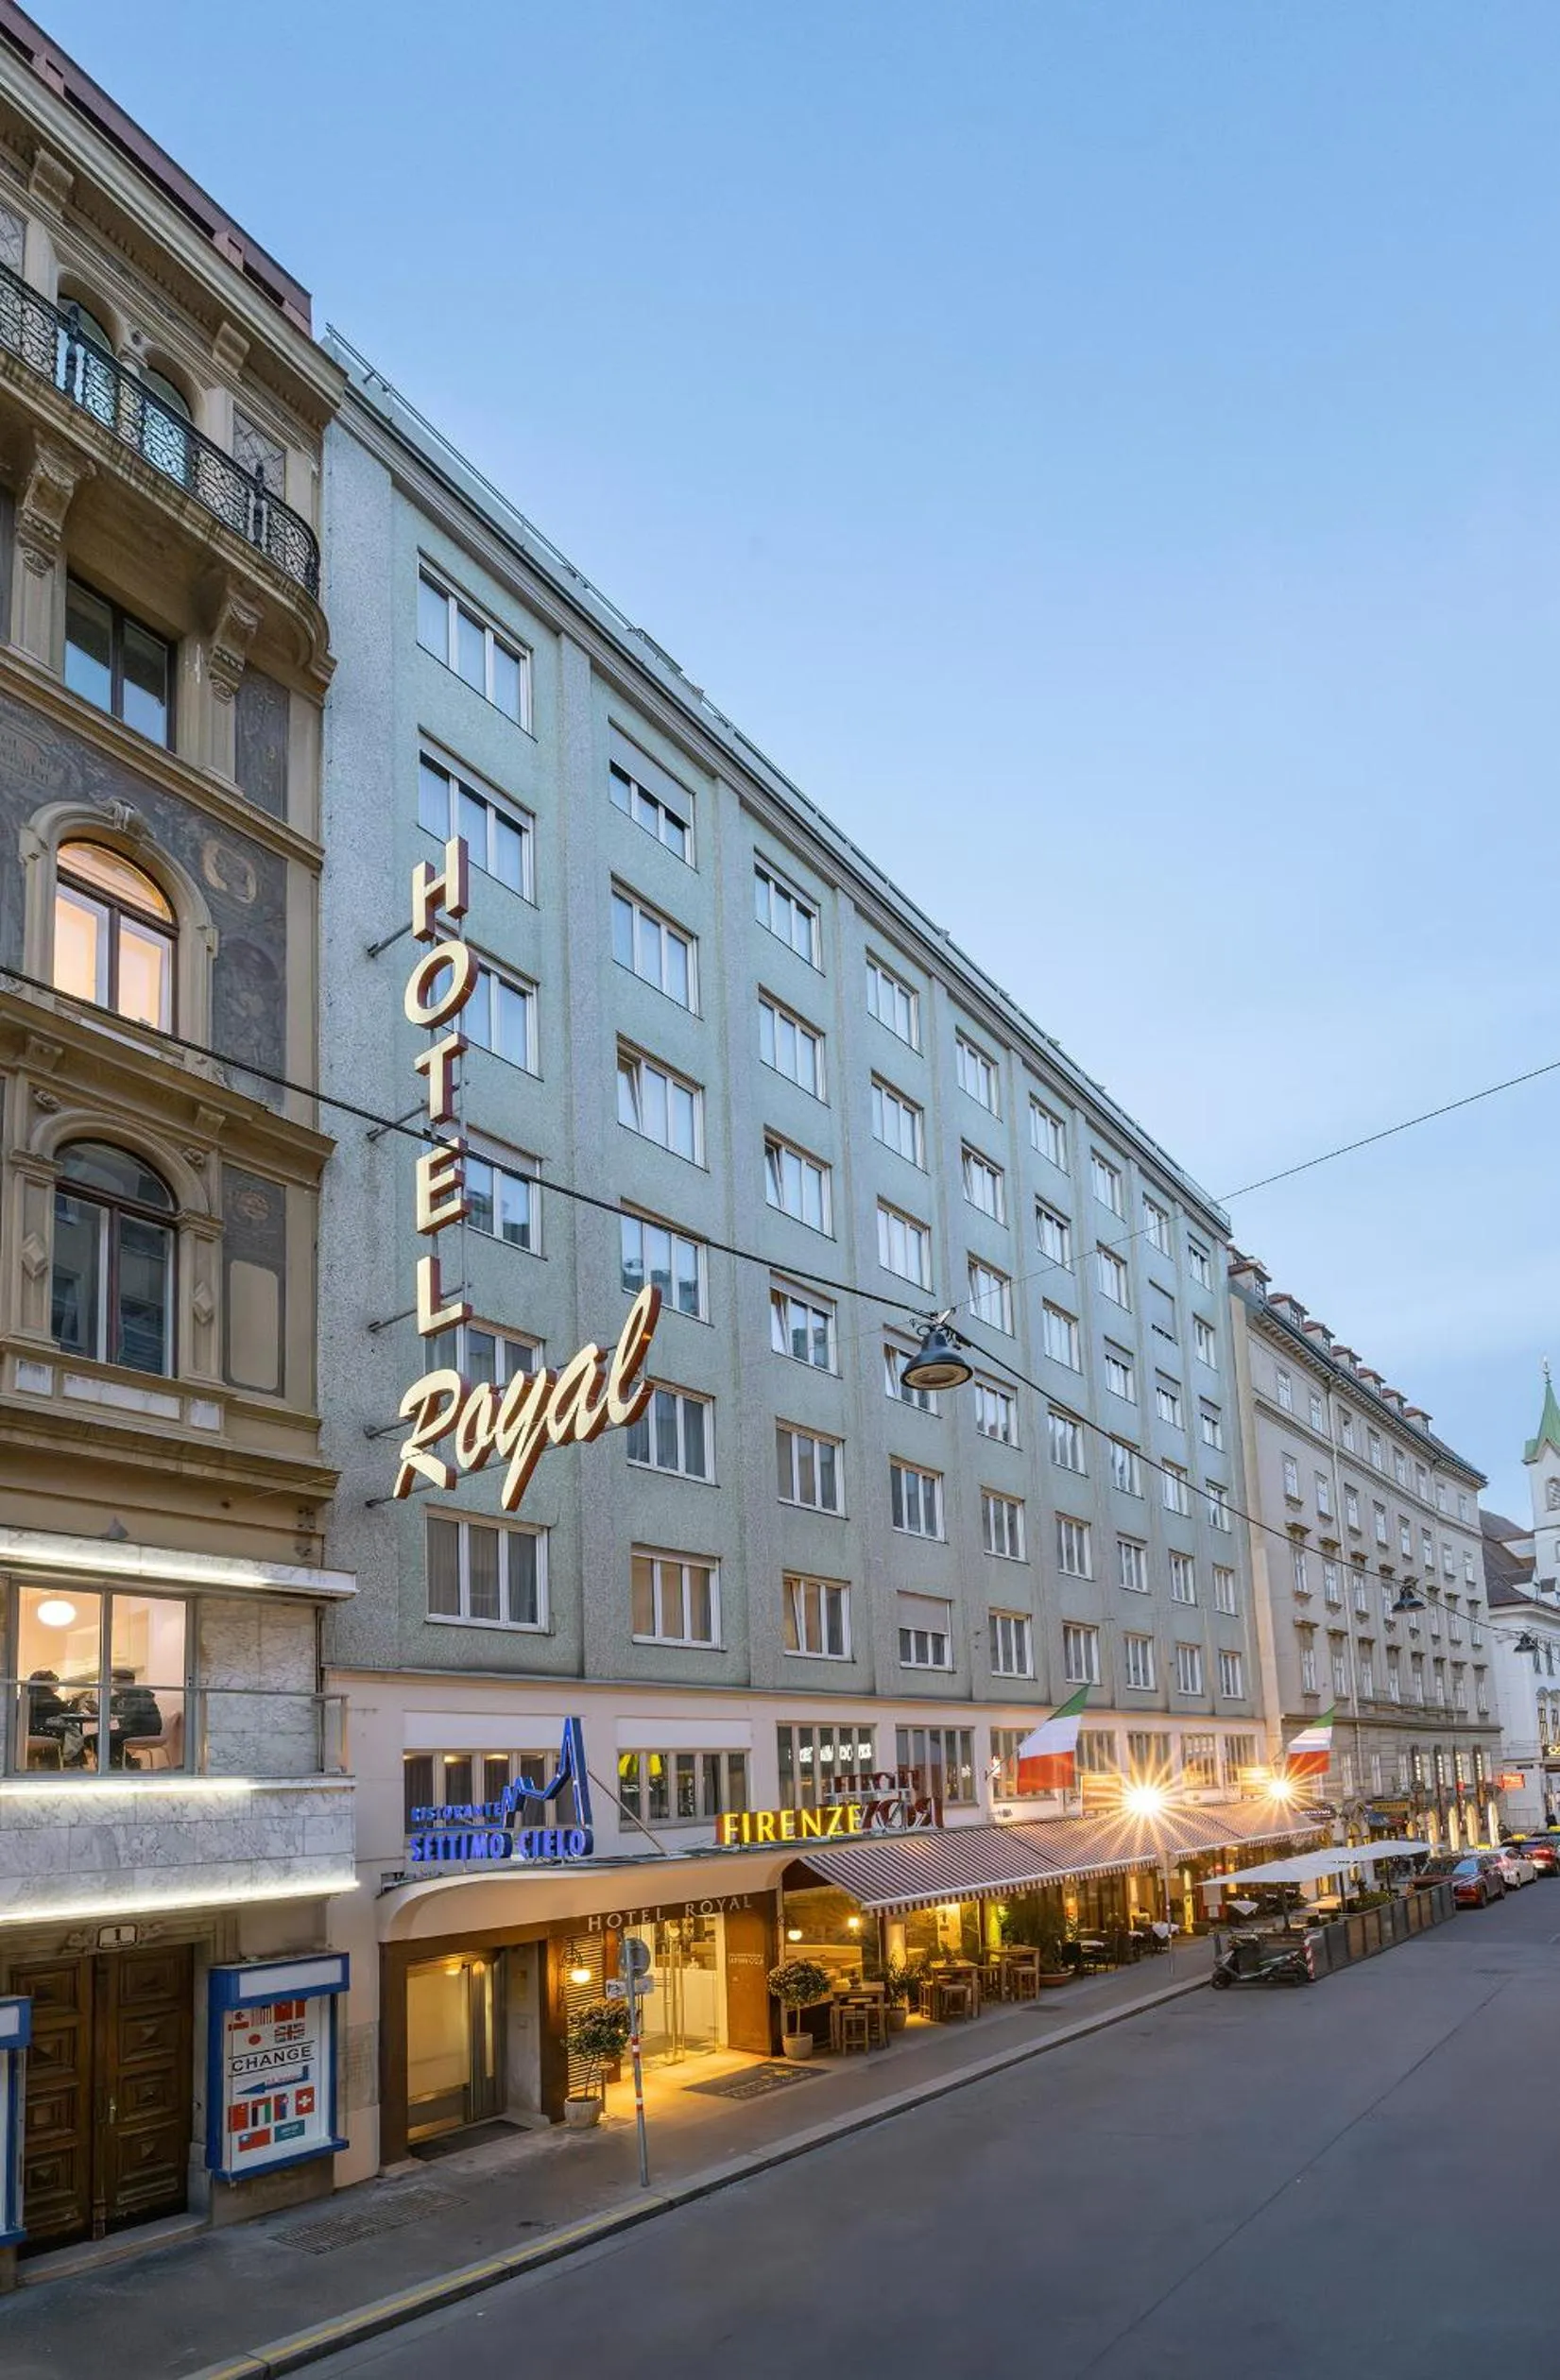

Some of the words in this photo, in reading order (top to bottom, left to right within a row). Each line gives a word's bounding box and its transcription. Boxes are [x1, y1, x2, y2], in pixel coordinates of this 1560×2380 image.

[404, 835, 477, 1338] HOTEL
[393, 1283, 661, 1512] Royal
[409, 1831, 511, 1862] SETTIMO
[519, 1827, 593, 1859] CIELO
[718, 1804, 863, 1846] FIRENZE
[588, 1907, 666, 1932] HOTEL
[684, 1894, 753, 1918] ROYAL
[231, 2045, 312, 2073] CHANGE
